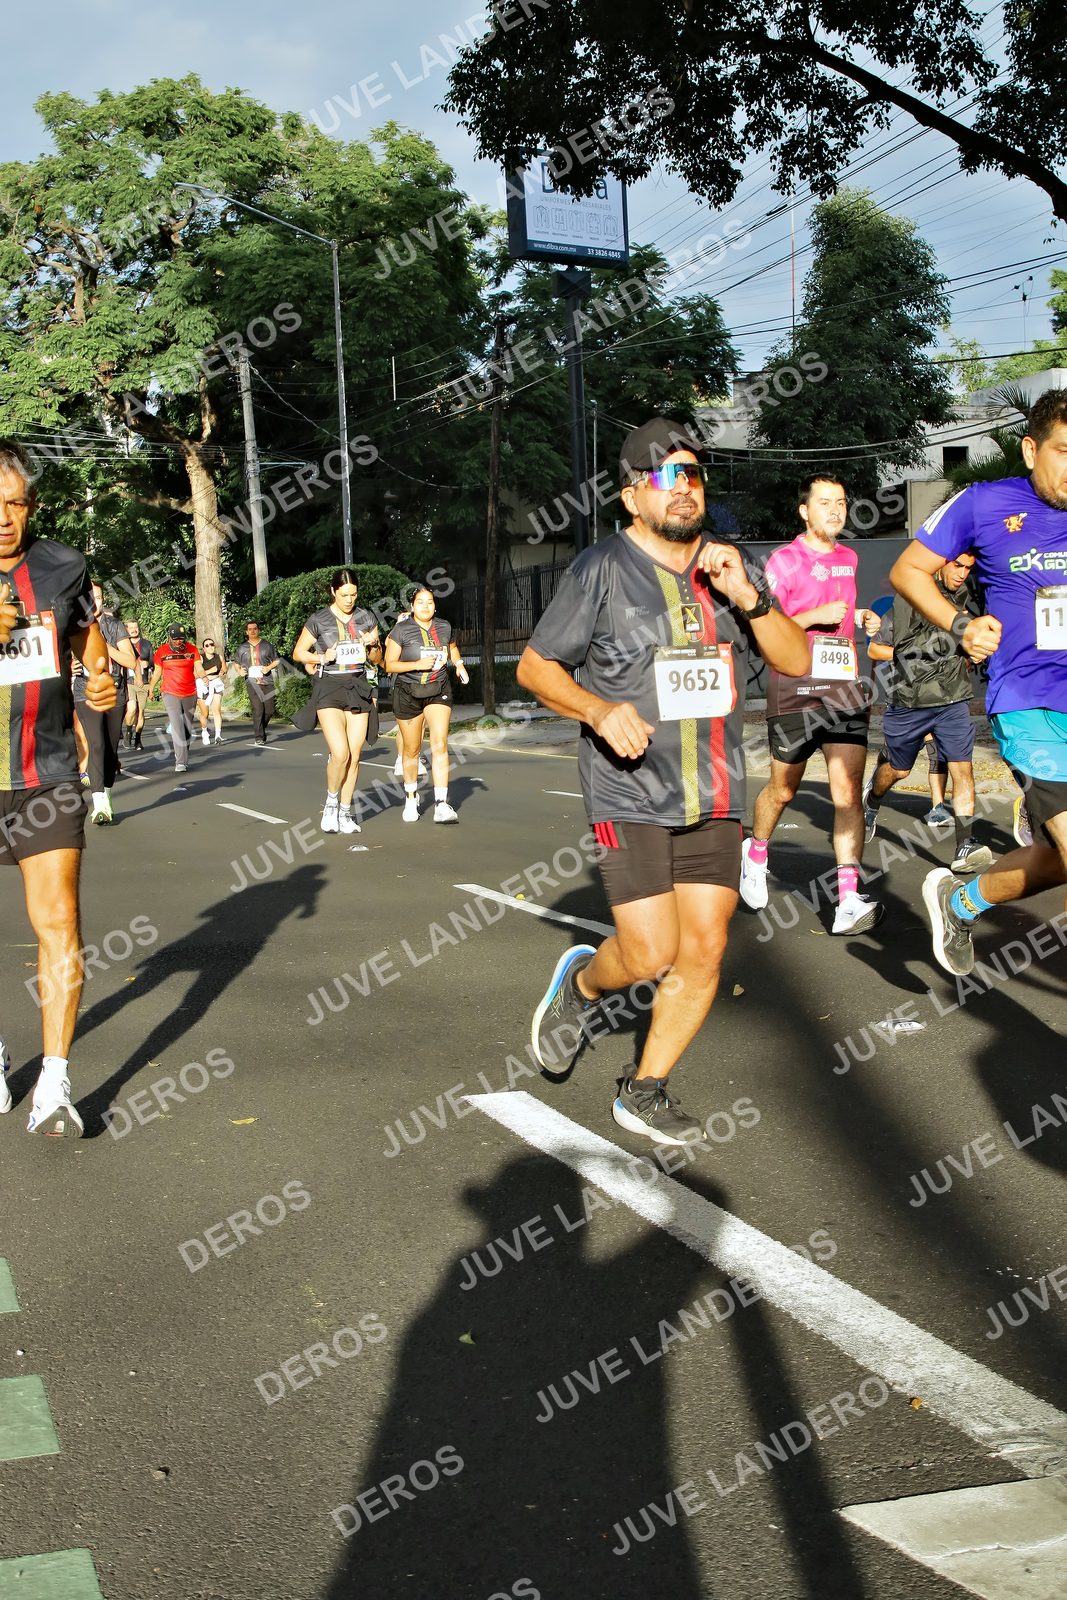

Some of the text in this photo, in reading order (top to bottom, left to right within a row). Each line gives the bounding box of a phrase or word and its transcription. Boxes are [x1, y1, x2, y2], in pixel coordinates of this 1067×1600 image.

[1044, 558, 1067, 570] GD
[1041, 607, 1064, 627] 11
[820, 650, 850, 665] 8498
[668, 668, 721, 693] 9652
